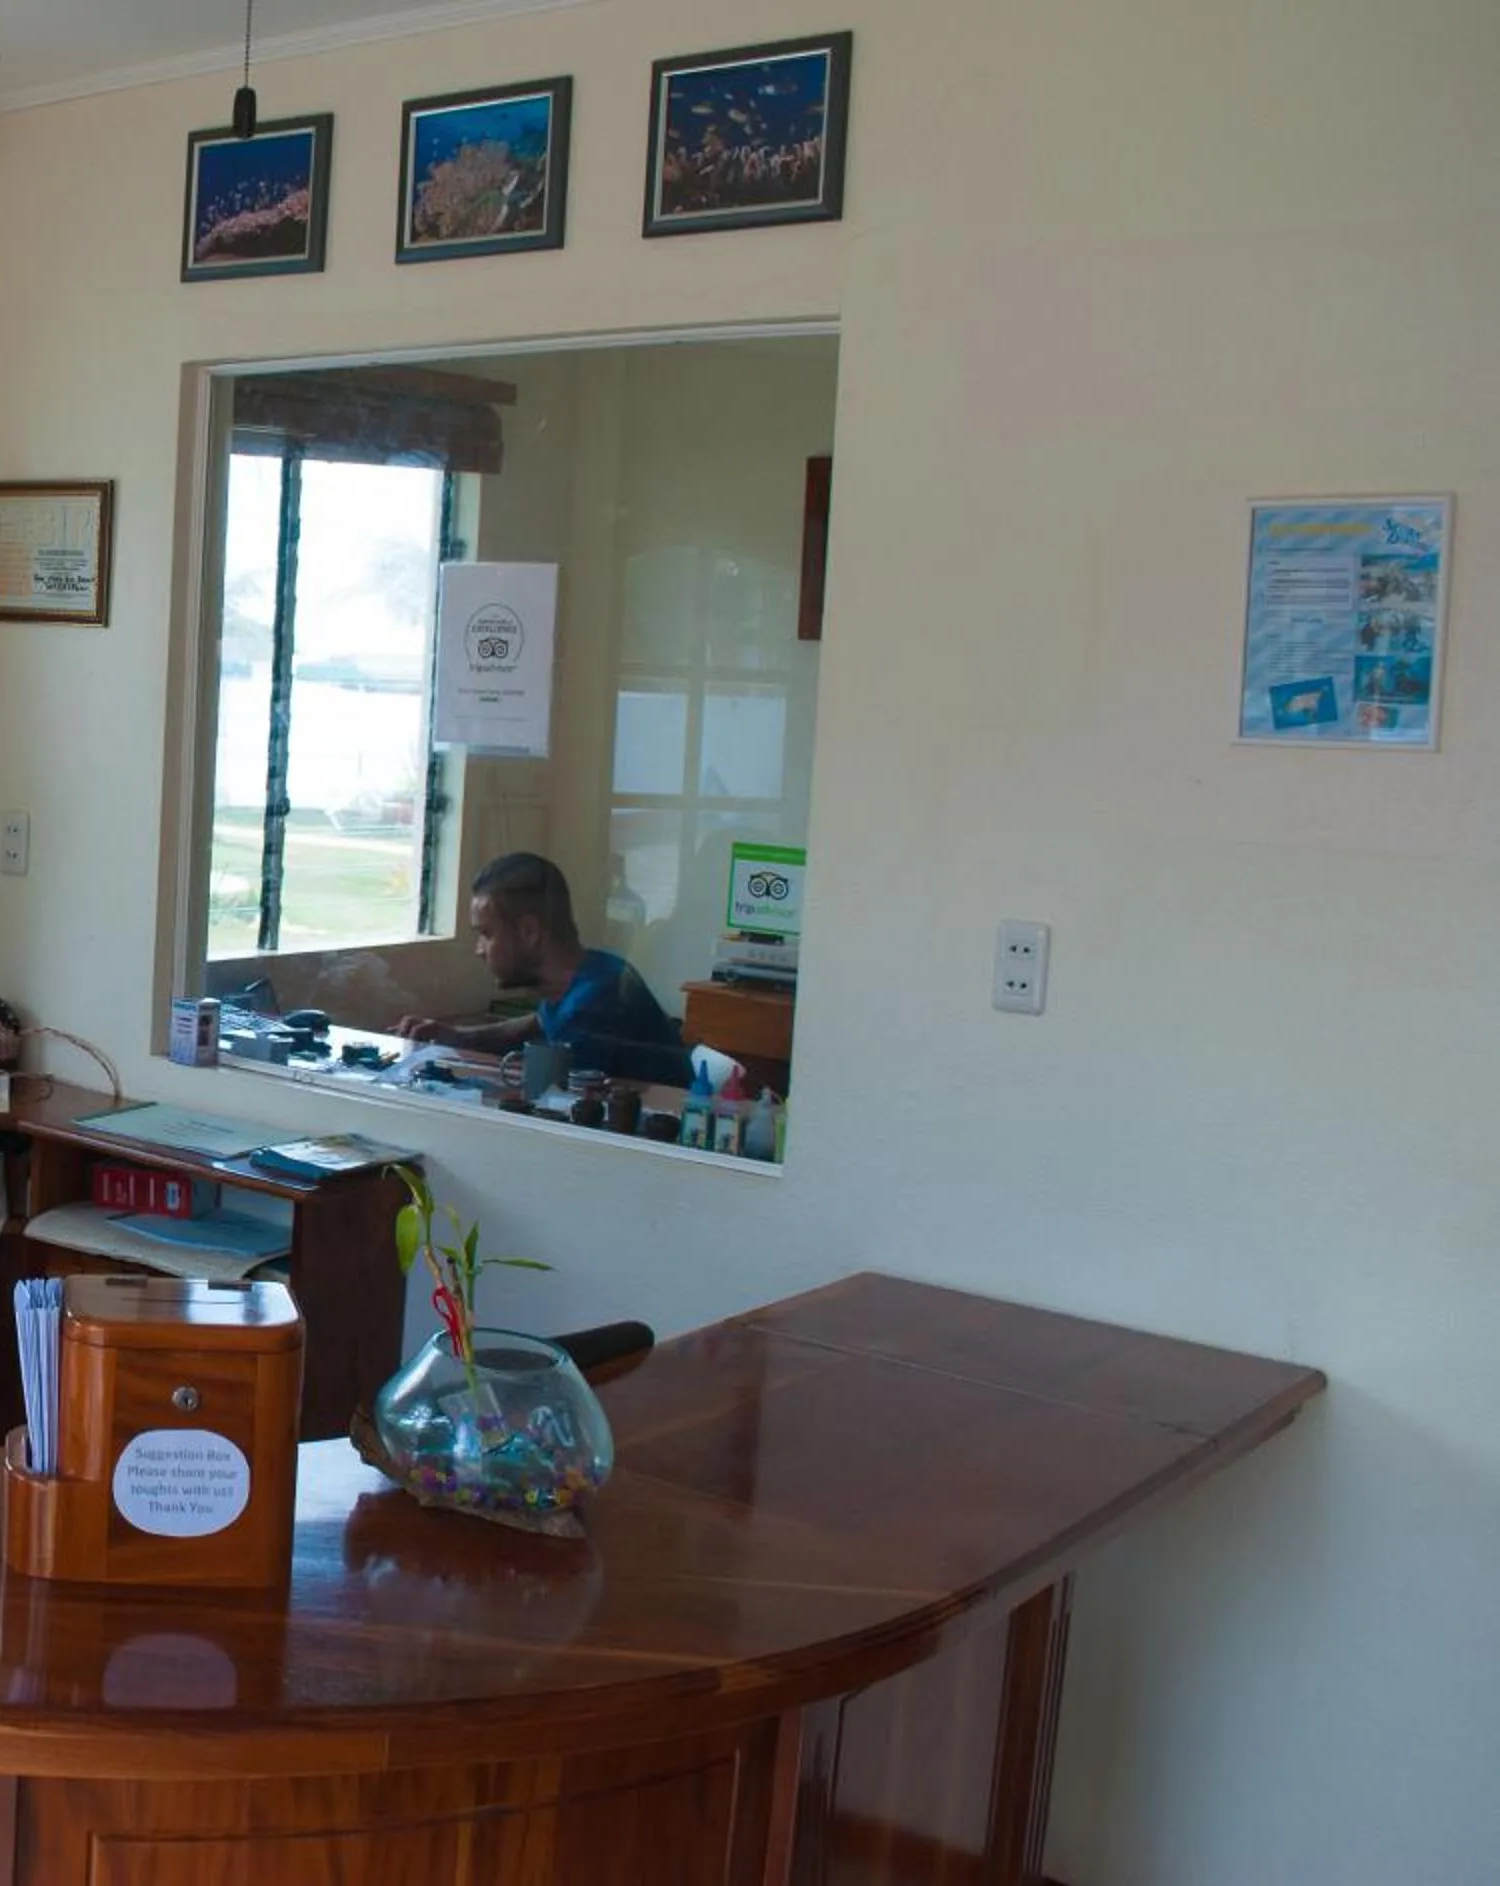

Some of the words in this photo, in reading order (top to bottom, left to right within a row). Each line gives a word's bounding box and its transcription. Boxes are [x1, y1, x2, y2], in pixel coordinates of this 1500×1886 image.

[135, 1448, 203, 1461] Suggestion
[207, 1449, 231, 1461] Box
[127, 1465, 167, 1478] Please
[171, 1465, 205, 1478] share
[209, 1469, 238, 1481] your
[182, 1484, 211, 1497] with
[149, 1501, 186, 1513] Thank
[188, 1501, 213, 1514] You
